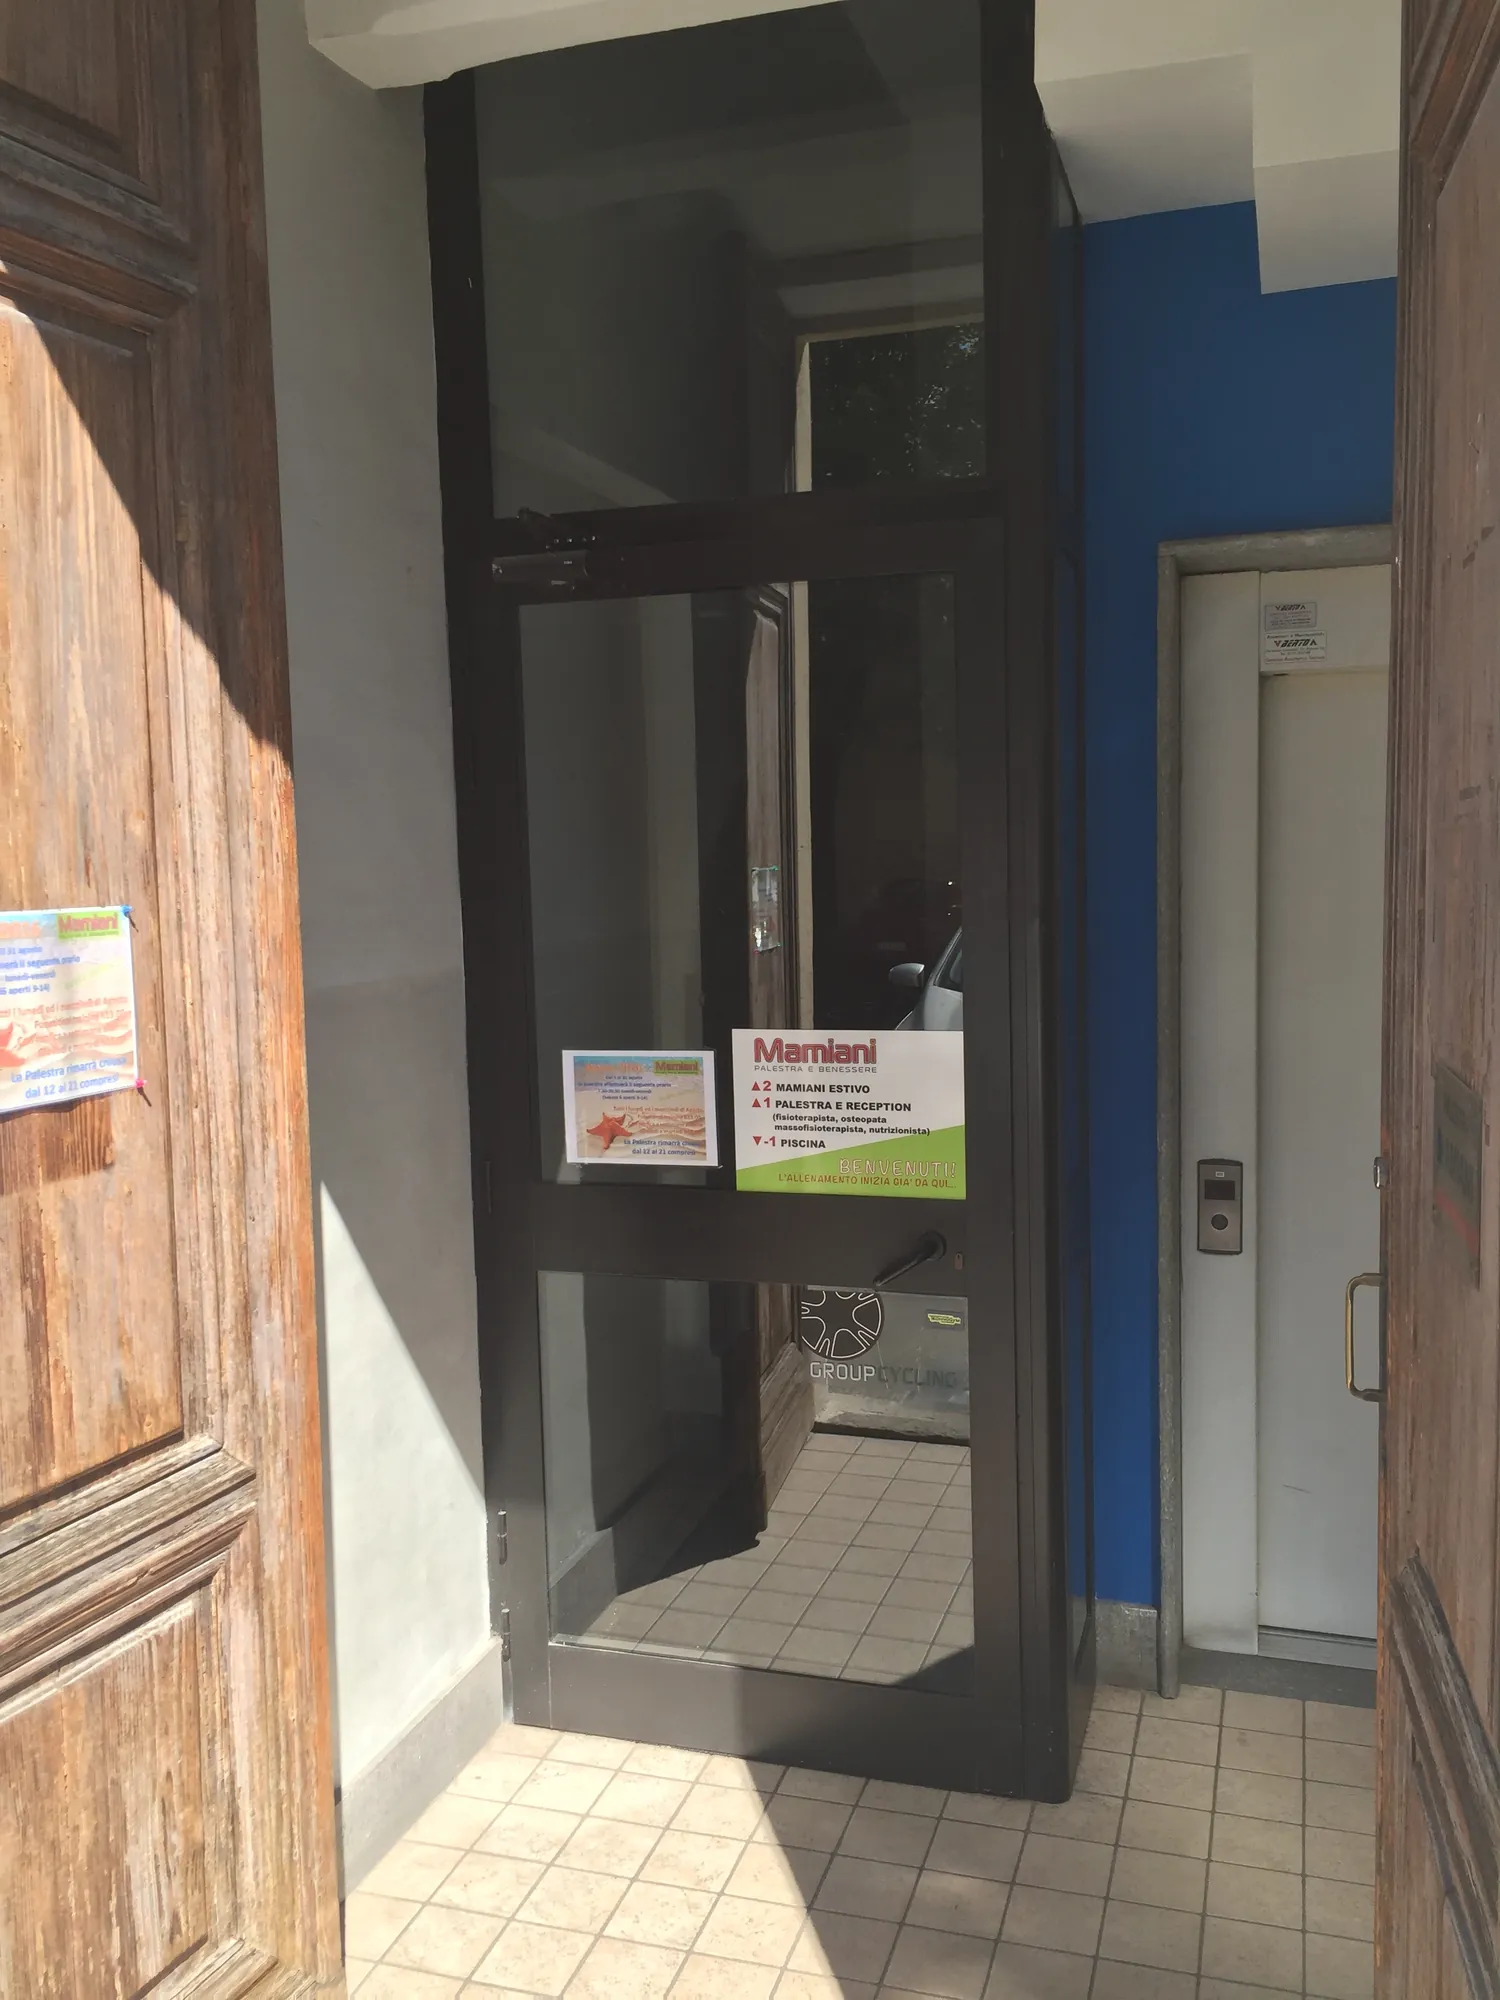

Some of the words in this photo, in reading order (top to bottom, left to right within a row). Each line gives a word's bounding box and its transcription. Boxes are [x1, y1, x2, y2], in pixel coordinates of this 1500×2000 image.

[754, 1037, 877, 1065] Mamiani
[25, 1067, 64, 1081] Palestra
[754, 1065, 803, 1073] PALESTRA
[25, 1085, 40, 1099] dal
[43, 1084, 55, 1095] 12
[58, 1082, 67, 1092] al
[763, 1081, 771, 1091] 2
[776, 1083, 826, 1093] MAMIANI
[829, 1084, 870, 1094] ESTIVO
[763, 1098, 771, 1108] 1
[775, 1100, 833, 1110] PALESTRA
[836, 1101, 843, 1110] E
[846, 1101, 911, 1112] RECEPTION
[772, 1113, 839, 1124] (fisioterapista,
[841, 1115, 887, 1124] osteopata
[774, 1123, 867, 1135] massofisioterapista,
[869, 1126, 930, 1136] nutrizionista)
[764, 1136, 776, 1147] -1
[781, 1139, 826, 1149] PISCINA
[839, 1157, 957, 1178] BENVENUTI!
[778, 1173, 857, 1185] L'ALLENAMENTO
[860, 1176, 890, 1186] INIZIA
[893, 1177, 912, 1187] GIA'
[915, 1177, 928, 1188] DA
